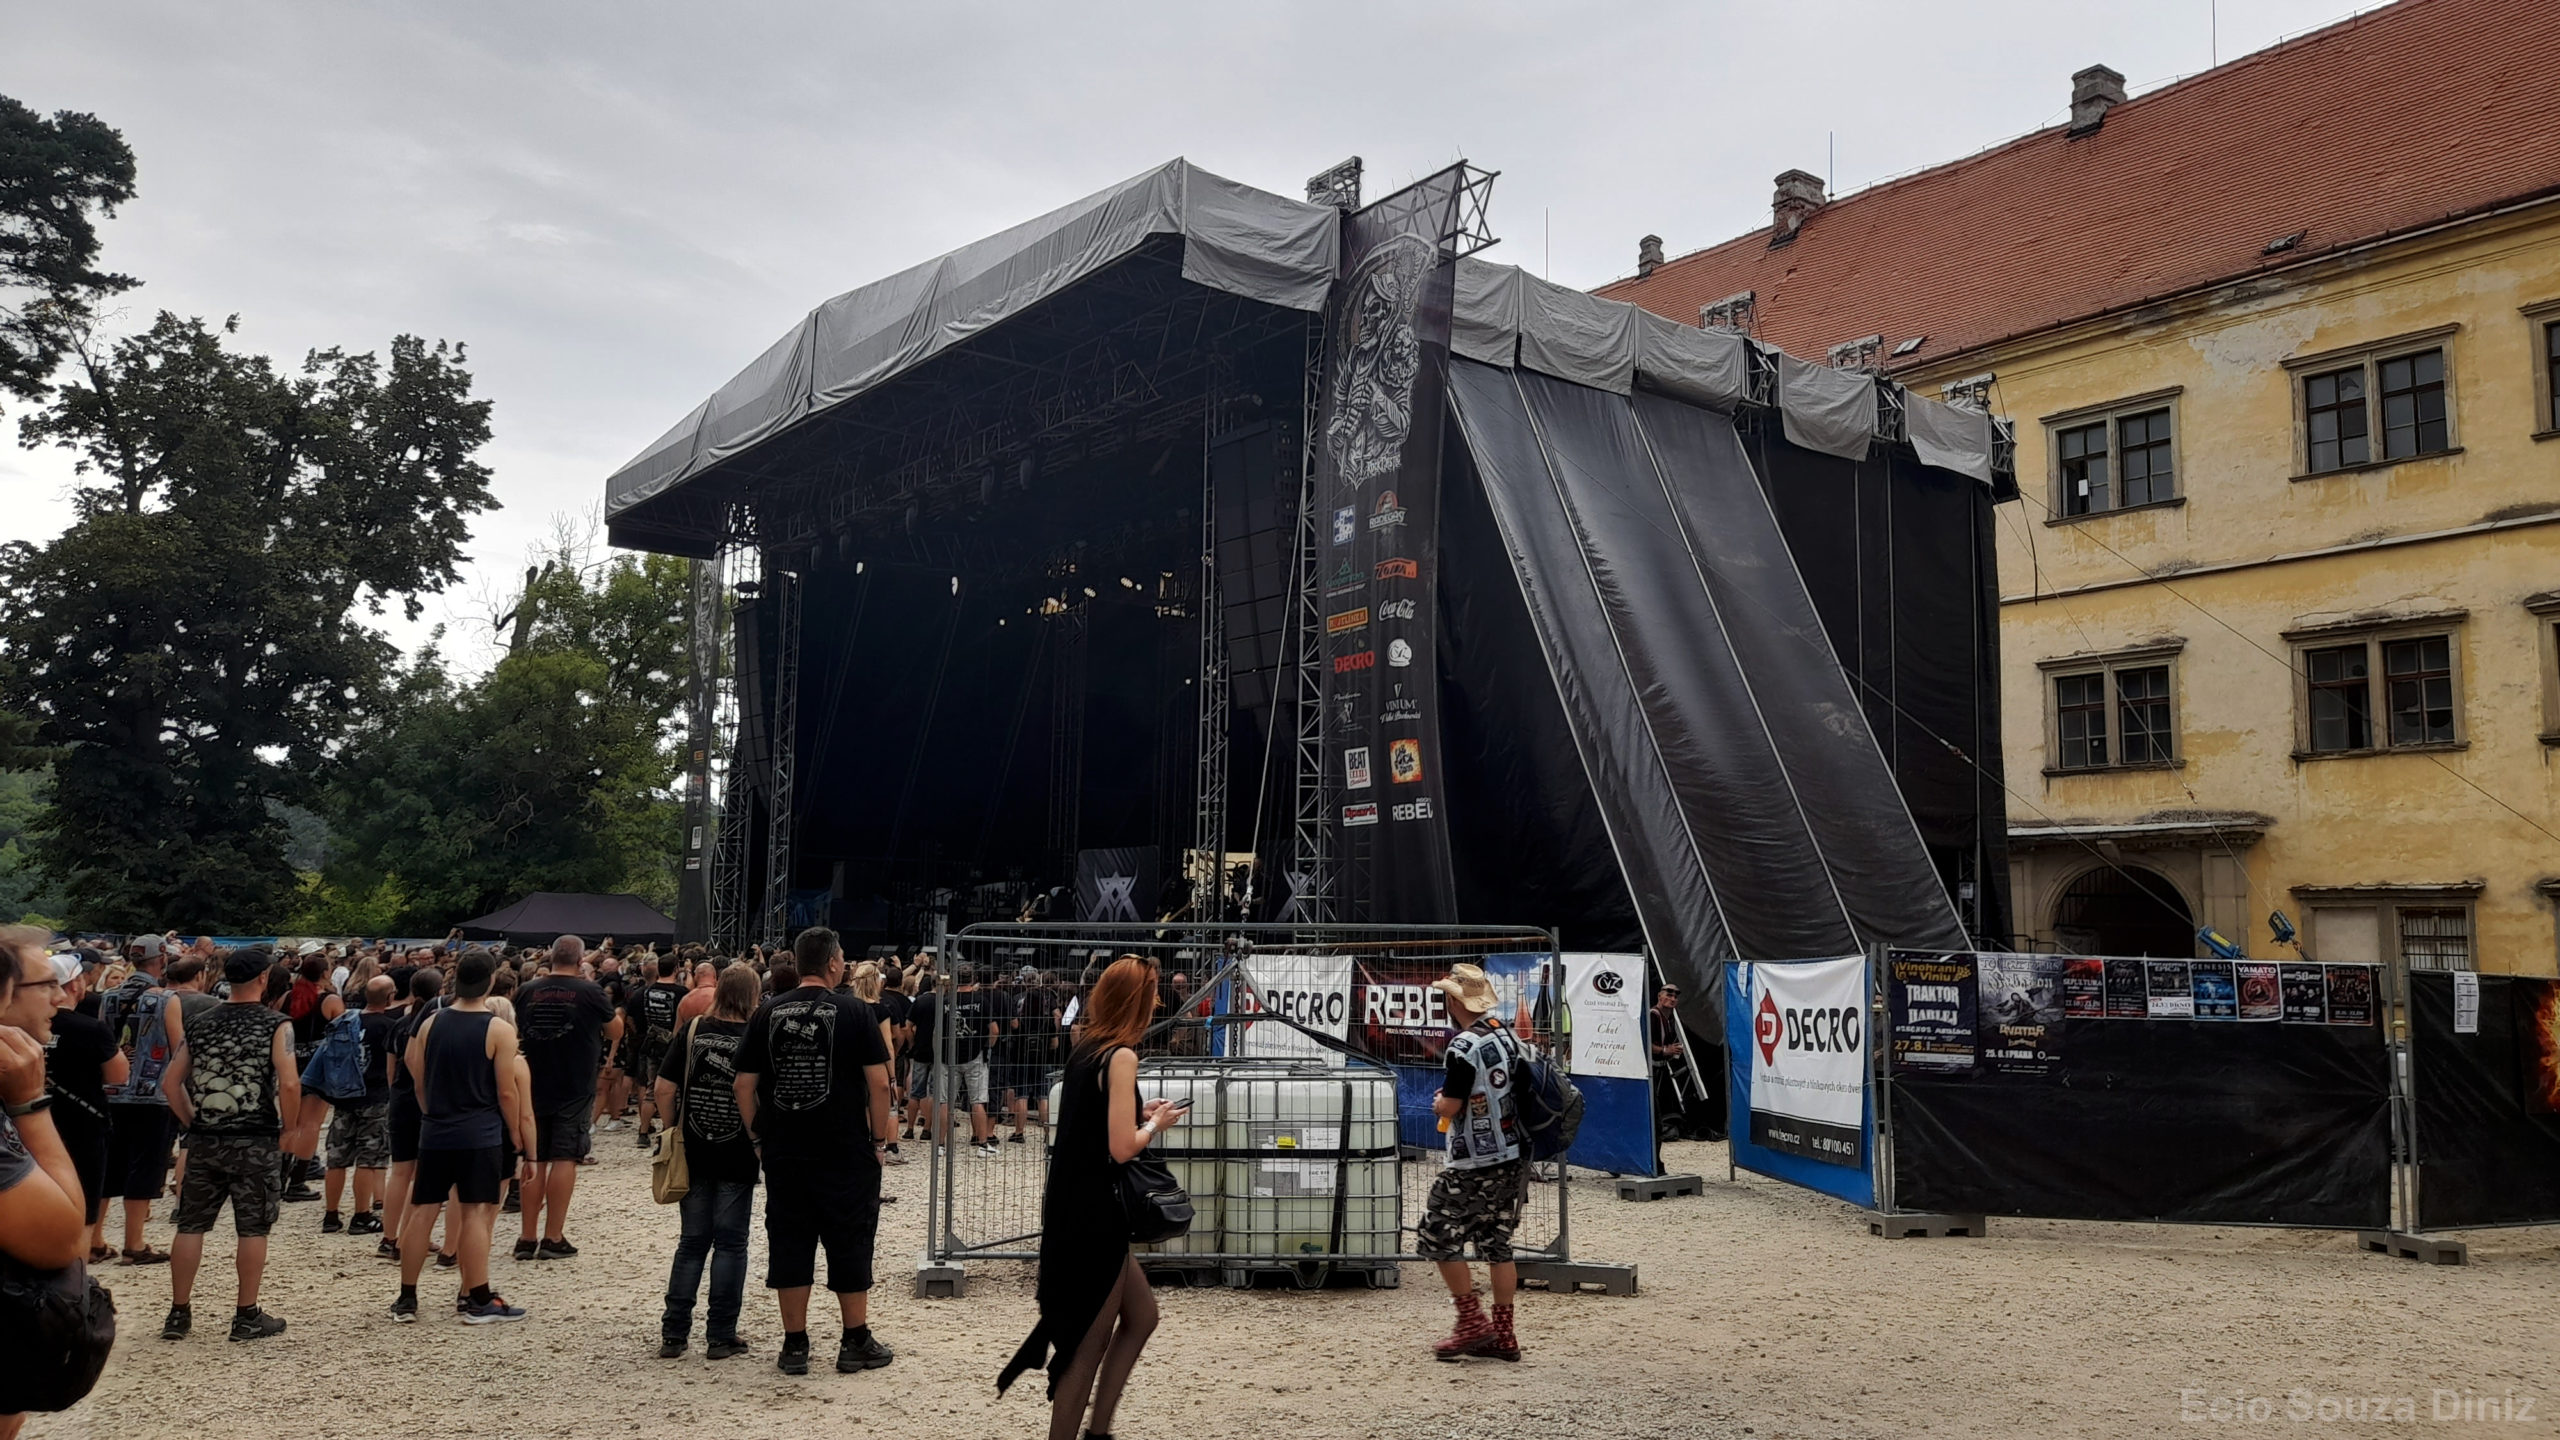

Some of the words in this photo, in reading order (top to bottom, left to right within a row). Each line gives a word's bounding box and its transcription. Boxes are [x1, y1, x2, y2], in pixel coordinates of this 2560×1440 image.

[1378, 598, 1416, 621] Coca-Cola
[1334, 651, 1375, 674] DECRO
[1348, 750, 1366, 769] BEAT
[1392, 802, 1434, 822] REBEL
[2191, 963, 2232, 971] GENESIS
[2237, 965, 2276, 974] YAMATO
[1905, 984, 1960, 1009] TRAKTOR
[1267, 989, 1345, 1026] DECRO
[1364, 985, 1453, 1029] REBE
[1597, 1018, 1622, 1035] Chuť
[1908, 1008, 1958, 1027] HARLEJ
[1785, 1006, 1861, 1053] DECRO
[1842, 1140, 1855, 1156] 451
